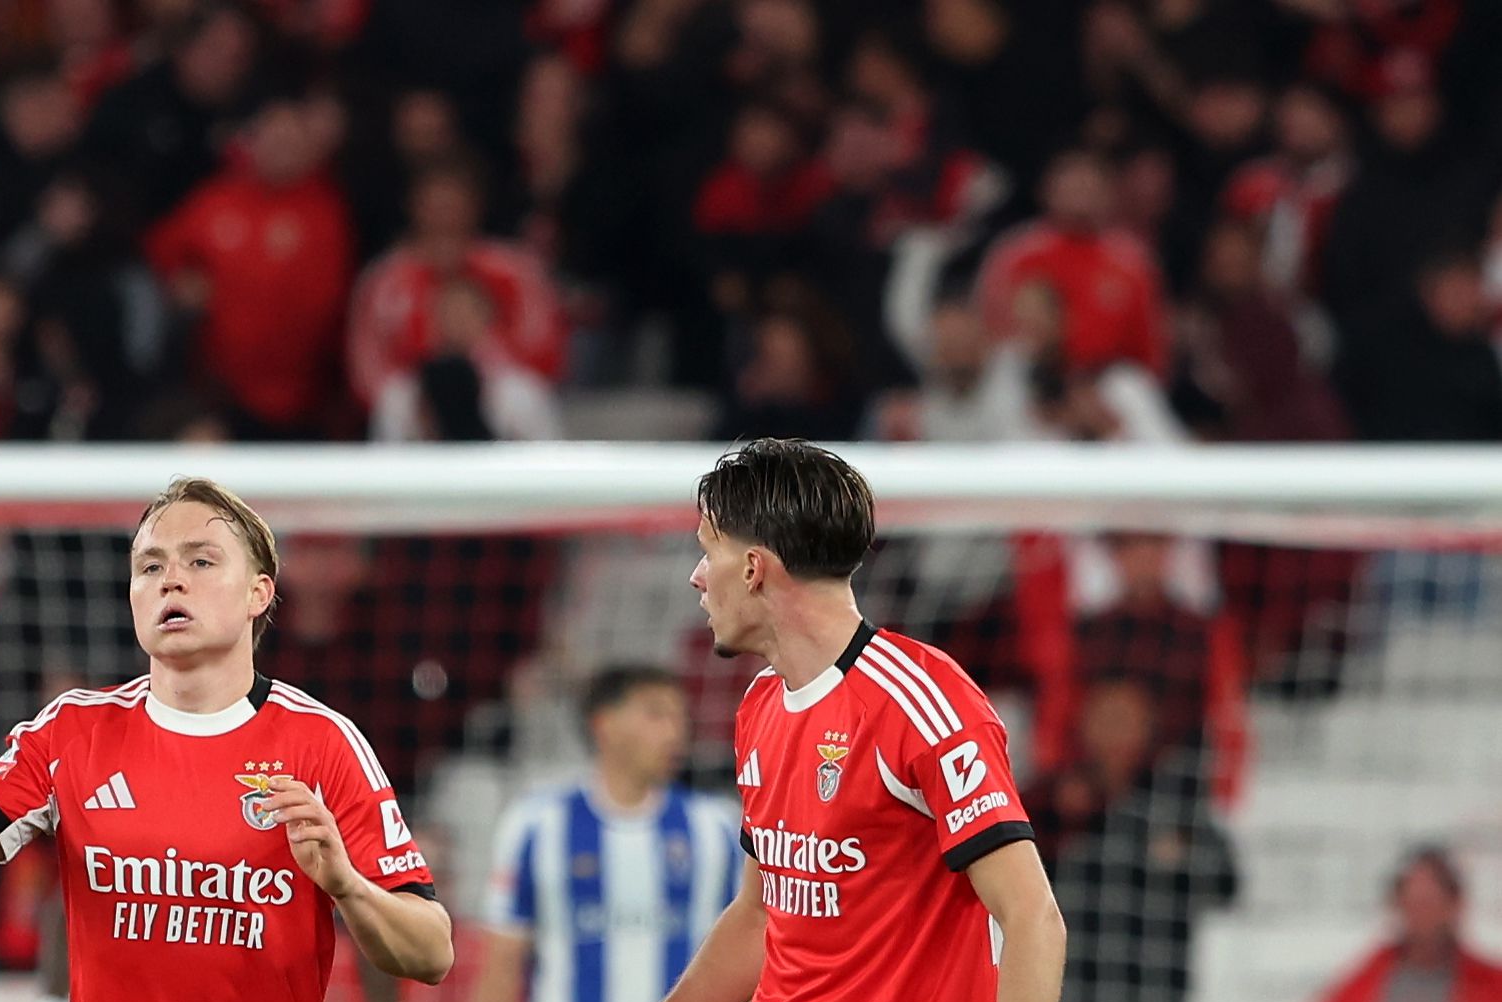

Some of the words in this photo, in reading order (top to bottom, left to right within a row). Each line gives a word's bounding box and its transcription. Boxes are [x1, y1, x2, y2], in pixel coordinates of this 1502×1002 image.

[945, 791, 1009, 835] Betano
[378, 849, 427, 876] Beta
[745, 816, 866, 874] mirates
[84, 845, 294, 905] Emirates
[779, 875, 840, 918] BETTER
[113, 901, 158, 941] FLY
[165, 904, 264, 950] BETTER
